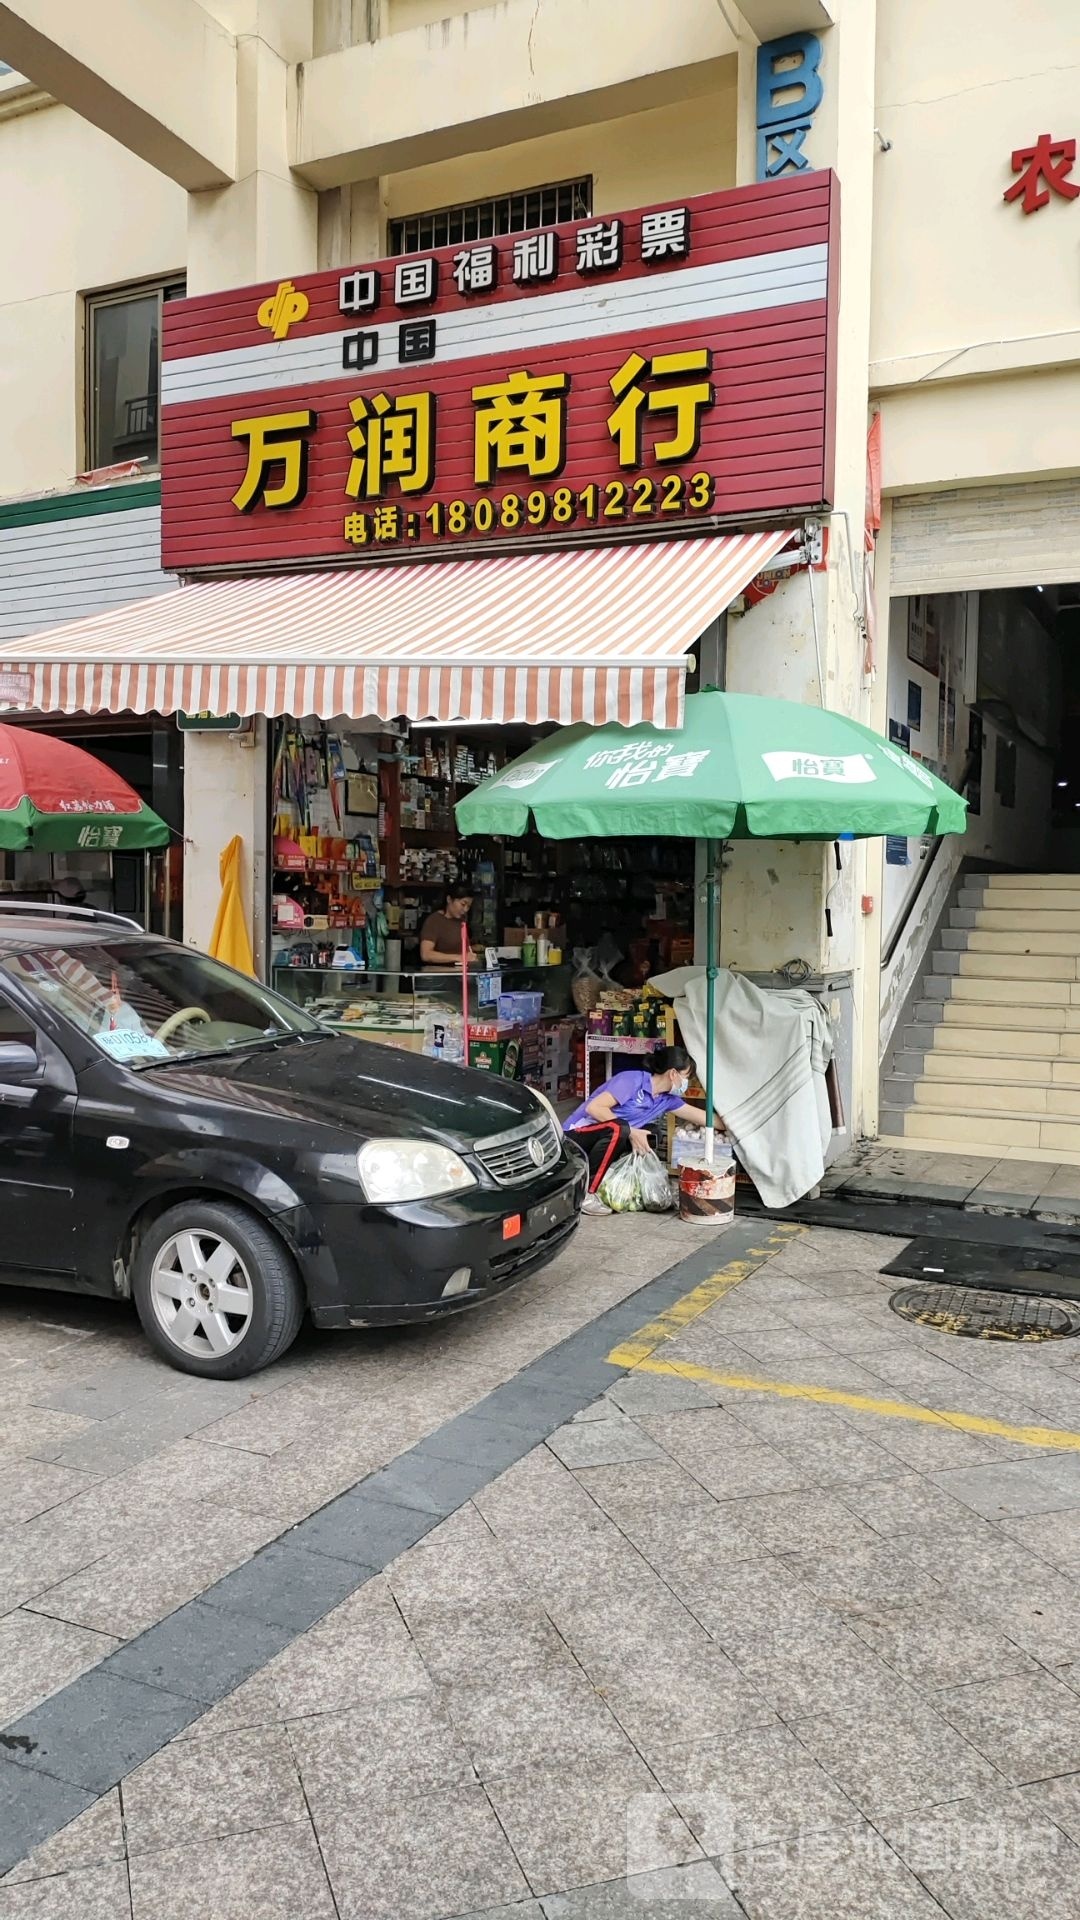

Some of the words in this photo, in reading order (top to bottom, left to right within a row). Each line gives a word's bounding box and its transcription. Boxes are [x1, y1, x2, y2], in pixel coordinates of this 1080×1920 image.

[1003, 134, 1080, 214] 农
[338, 206, 690, 315] 中国福利彩票
[341, 319, 436, 371] 中国
[230, 348, 712, 511] 万润商行
[582, 740, 675, 771] 你我的
